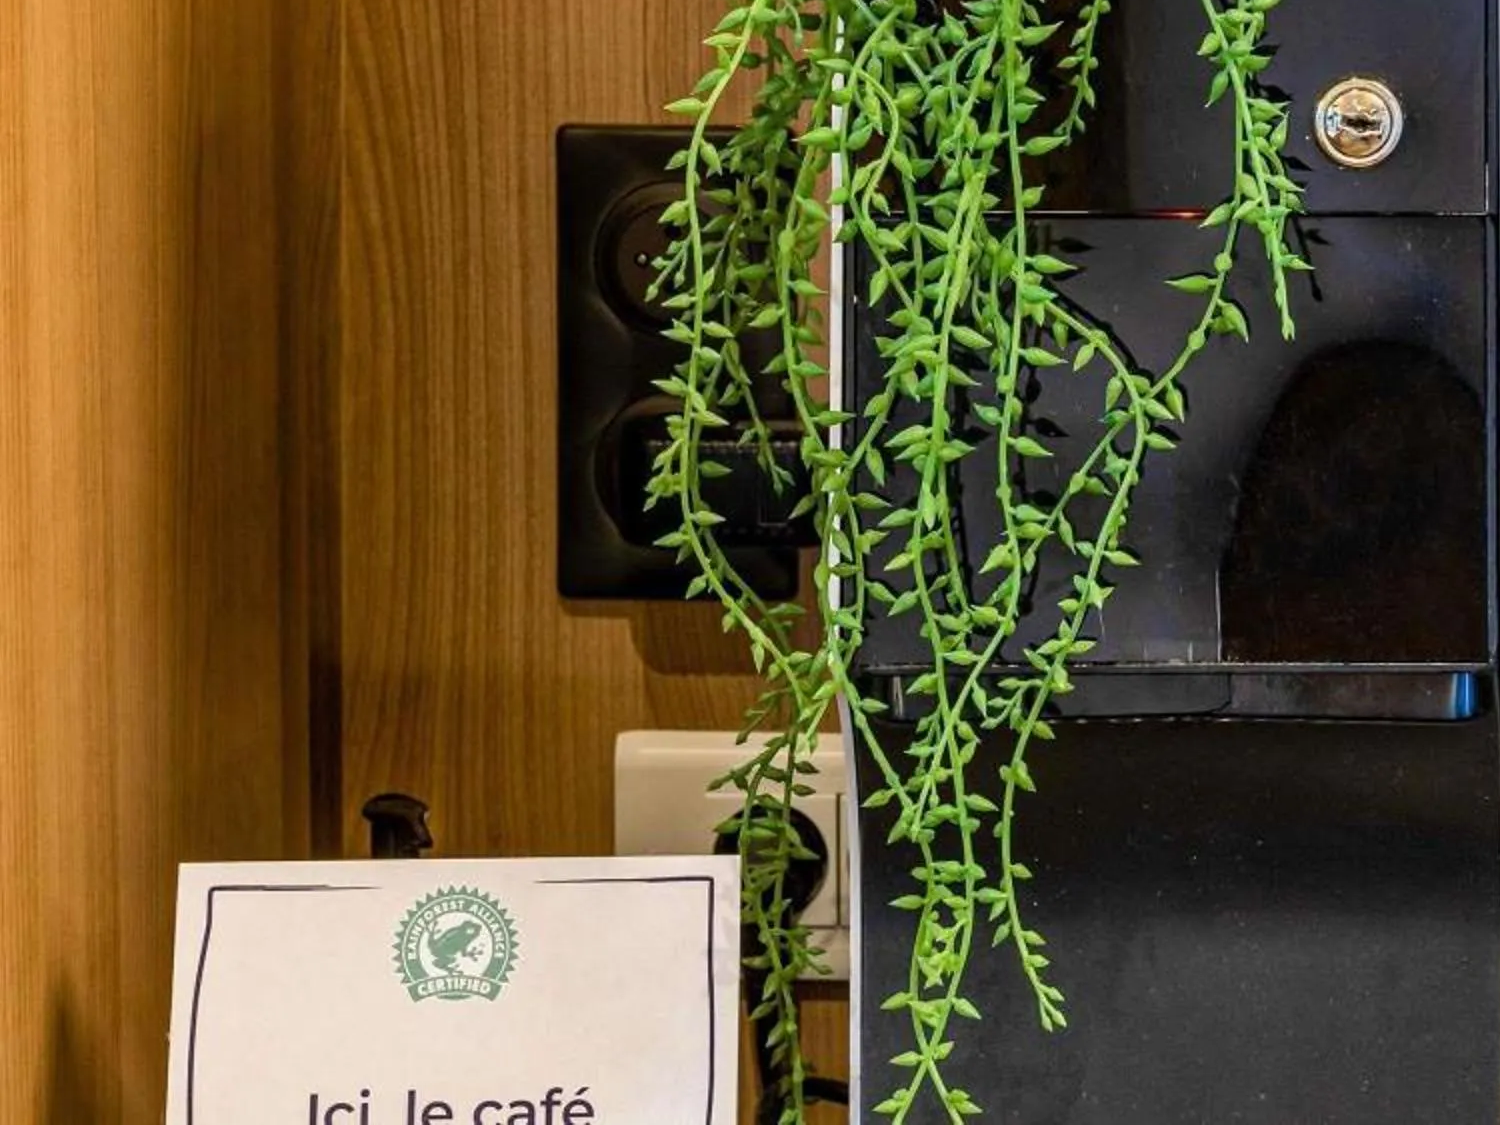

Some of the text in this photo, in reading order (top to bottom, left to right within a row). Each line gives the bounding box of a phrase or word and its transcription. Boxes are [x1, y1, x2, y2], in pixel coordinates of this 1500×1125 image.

[407, 899, 506, 961] RAINFOREST ALLIANCE
[417, 977, 492, 995] CERTIFIED
[407, 1089, 454, 1125] le
[473, 1086, 597, 1125] café
